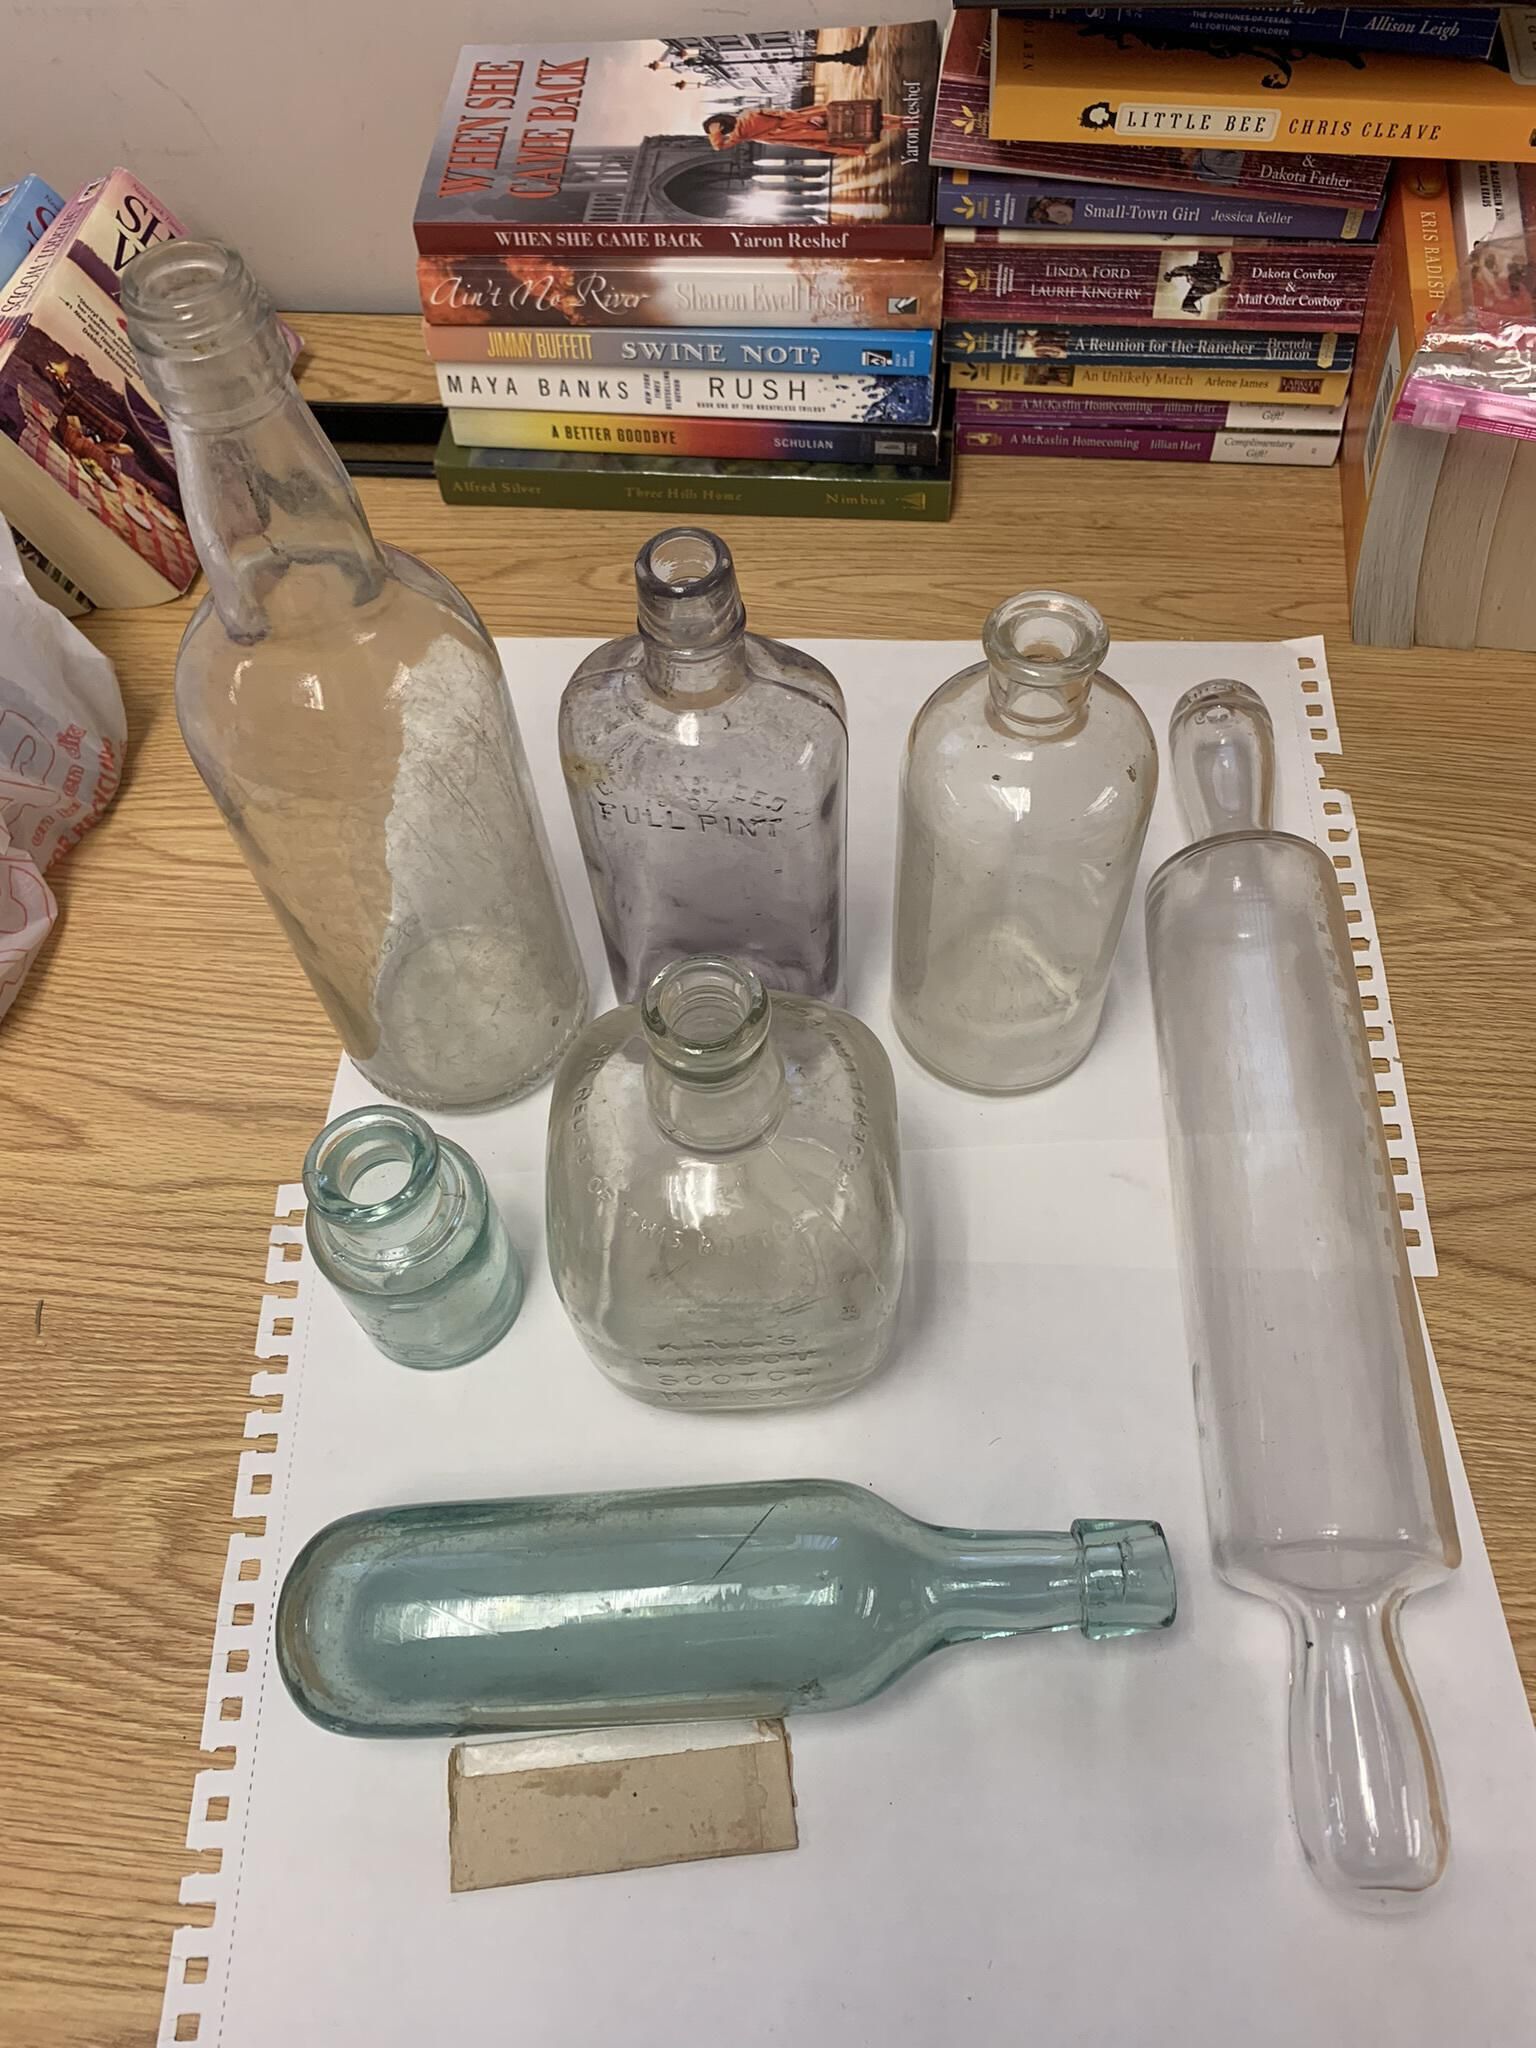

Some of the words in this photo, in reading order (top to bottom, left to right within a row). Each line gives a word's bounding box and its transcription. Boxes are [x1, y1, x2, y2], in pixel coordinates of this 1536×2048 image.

[1364, 15, 1416, 33] Allison
[1418, 19, 1461, 41] Leigh
[464, 60, 524, 109] SHE
[527, 57, 590, 122] BACK
[902, 80, 920, 124] Reshef
[1127, 110, 1212, 131] LITTLE
[1224, 114, 1268, 133] BEE
[1288, 117, 1352, 136] CHRIS
[1361, 121, 1442, 140] CLEAVE
[901, 127, 919, 165] Yaron
[437, 115, 512, 198] WHEN
[508, 128, 575, 199] CAME
[1259, 164, 1306, 184] Dakota
[1310, 171, 1352, 189] Father
[1084, 203, 1168, 221] Small-Town
[1172, 207, 1200, 222] Girl
[1211, 209, 1253, 223] Jessica
[1257, 211, 1293, 225] Keller
[1420, 211, 1439, 242] KRIS
[494, 231, 551, 248] WHEN
[557, 231, 594, 248] SHE
[597, 232, 649, 248] CAME
[654, 232, 704, 248] BACK
[730, 232, 783, 248] Yaron
[788, 232, 850, 248] Reshef
[1045, 264, 1088, 279] LINDA
[1092, 265, 1131, 280] FORD
[1251, 267, 1291, 280] Dakota
[1293, 267, 1338, 284] Cowboy
[1424, 247, 1445, 299] RADISH
[1, 262, 48, 313] WOODS
[430, 275, 502, 309] Ain't
[510, 275, 561, 312] No
[570, 272, 651, 316] River
[1030, 284, 1077, 298] LAURIE
[1082, 285, 1142, 300] KINGERY
[1285, 281, 1297, 293] &
[675, 282, 748, 313] Sharon
[753, 281, 800, 312] Ewell
[806, 284, 866, 313] Foster
[1236, 293, 1262, 306] Mail
[1264, 293, 1297, 306] Order
[1299, 294, 1343, 310] Cowboy
[486, 331, 532, 359] JIMMY
[536, 332, 594, 361] BUFFETT
[1074, 338, 1087, 351] A
[1090, 338, 1145, 352] Reunion
[1149, 338, 1168, 352] for
[1171, 339, 1195, 353] the
[1198, 340, 1255, 355] Rancher
[1267, 337, 1313, 349] Brenda
[621, 341, 727, 363] SWINE
[740, 344, 822, 367] NOT?
[1265, 348, 1310, 361] Minton
[1082, 369, 1099, 382] An
[1102, 369, 1152, 386] Unlikely
[1155, 372, 1194, 386] Match
[1204, 376, 1238, 388] Arlene
[1239, 377, 1269, 390] James
[446, 375, 519, 397] MAYA
[538, 377, 630, 401] BANKS
[708, 376, 807, 401] RUSH
[1020, 399, 1029, 410] A
[1032, 399, 1081, 411] McKaslin
[1084, 400, 1152, 414] Homecoming
[1163, 403, 1194, 414] Jillian
[1196, 403, 1216, 414] Hart
[552, 424, 560, 438] A
[565, 426, 611, 441] BETTER
[617, 427, 677, 445] GOODBYE
[773, 437, 833, 450] SCHULIAN
[1009, 434, 1018, 445] A
[1021, 434, 1069, 446] McKaslin
[1072, 437, 1140, 451] Homecoming
[1150, 439, 1178, 450] Jillian
[1180, 440, 1201, 450] Hart
[452, 480, 497, 494] Alfred
[501, 482, 542, 495] Silver
[625, 486, 663, 499] Three
[703, 489, 742, 502] Home
[826, 492, 885, 505] Nimbus
[598, 800, 686, 831] FULL
[697, 813, 782, 837] PINT
